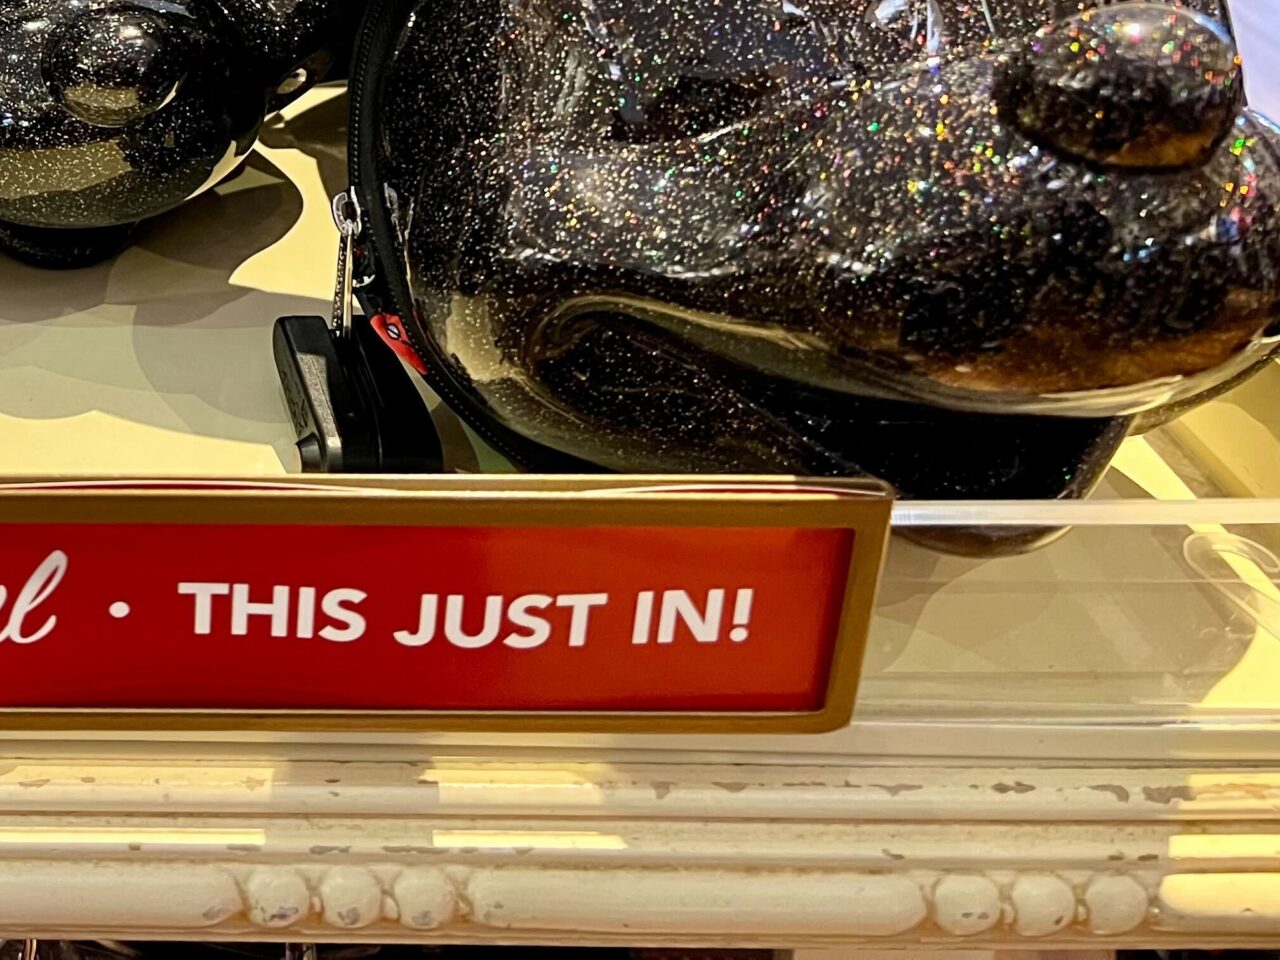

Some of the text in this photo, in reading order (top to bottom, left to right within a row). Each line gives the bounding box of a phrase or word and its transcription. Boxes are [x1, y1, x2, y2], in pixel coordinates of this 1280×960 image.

[177, 582, 368, 642] THIS
[393, 592, 608, 648] JUST
[632, 588, 754, 644] IN!
